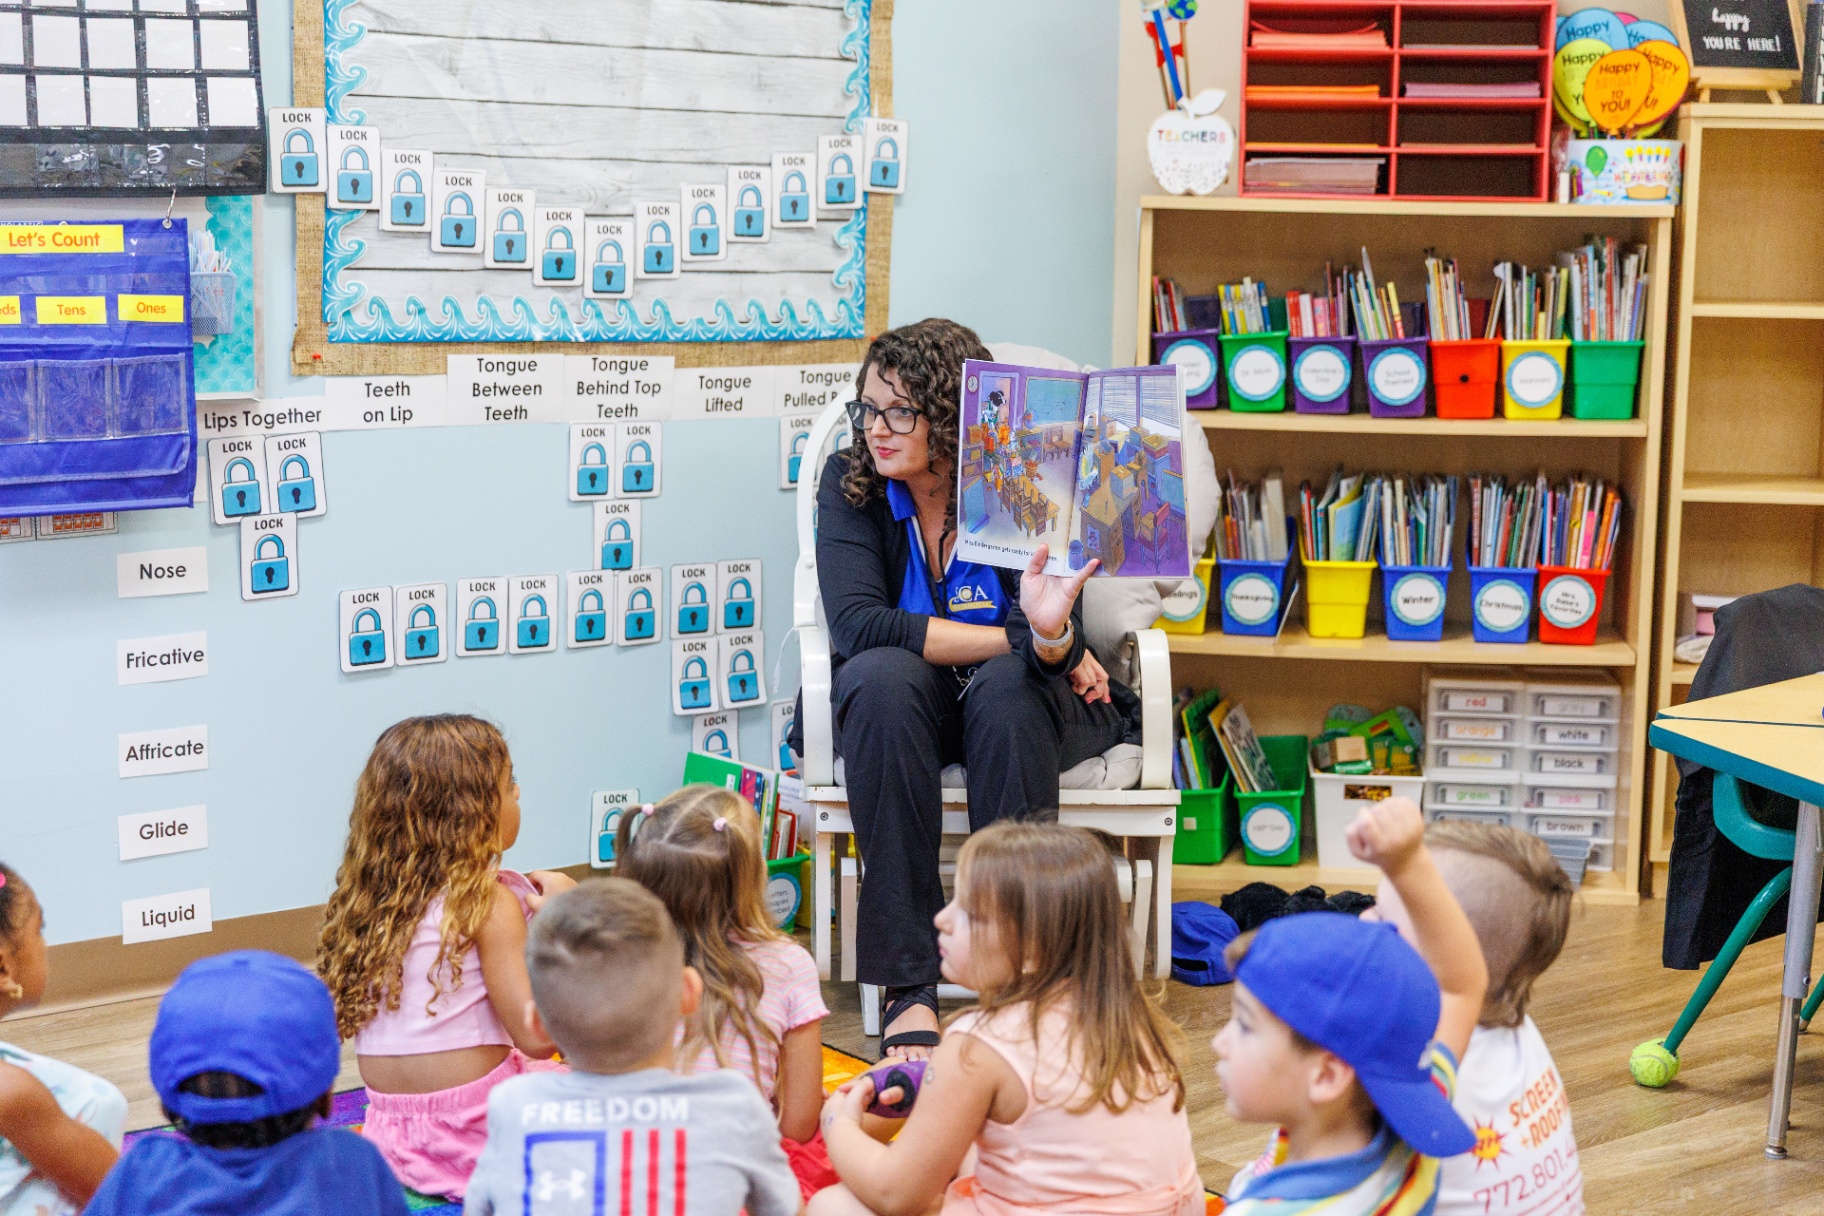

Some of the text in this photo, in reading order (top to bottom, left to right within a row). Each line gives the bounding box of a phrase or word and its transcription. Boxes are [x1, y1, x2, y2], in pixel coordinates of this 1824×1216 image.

[1565, 21, 1610, 40] Happy
[1747, 35, 1781, 52] HERE!
[1562, 51, 1605, 66] Happy
[1599, 62, 1640, 76] Happy
[1601, 98, 1631, 113] YOU!
[282, 113, 312, 123] LOCK
[876, 122, 899, 133] LOCK
[340, 130, 368, 141] LOCK
[1158, 129, 1226, 143] TEACHERS
[829, 138, 852, 149] LOCK
[394, 153, 421, 164] LOCK
[782, 156, 806, 166] LOCK
[738, 170, 761, 180] LOCK
[445, 176, 472, 187] LOCK
[498, 193, 523, 203] LOCK
[692, 188, 715, 198] LOCK
[546, 211, 572, 220] LOCK
[647, 206, 670, 215] LOCK
[597, 225, 622, 235] LOCK
[8, 232, 100, 247] Let's Count
[57, 304, 86, 316] Tens
[137, 302, 166, 314] Ones
[477, 358, 537, 376] Tongue
[591, 357, 649, 374] Tongue
[699, 375, 752, 392] Tongue
[800, 370, 851, 386] Tongue
[364, 381, 411, 398] Teeth
[472, 382, 542, 397] Between
[576, 380, 661, 397] Behind Top
[705, 398, 743, 412] Lifted
[784, 391, 826, 407] Pulled
[363, 406, 413, 424] on Lip
[485, 405, 528, 421] Teeth
[597, 404, 638, 419] Teeth
[204, 408, 322, 433] Lips Together
[790, 418, 813, 428] LOCK
[581, 428, 605, 437] LOCK
[627, 426, 651, 435] LOCK
[222, 441, 252, 453] LOCK
[277, 438, 307, 451] LOCK
[605, 504, 630, 514] LOCK
[254, 518, 284, 531] LOCK
[139, 563, 187, 580] Nose
[682, 568, 706, 578] LOCK
[728, 563, 751, 573] LOCK
[578, 575, 603, 584] LOCK
[628, 573, 652, 583] LOCK
[469, 582, 496, 592] LOCK
[520, 579, 546, 590] LOCK
[352, 592, 380, 604] LOCK
[409, 589, 435, 600] LOCK
[683, 642, 707, 652] LOCK
[730, 636, 754, 646] LOCK
[126, 648, 204, 669] Fricative
[1465, 693, 1486, 706] red
[703, 715, 728, 727] LOCK
[1455, 723, 1496, 737] orange
[1558, 730, 1589, 740] white
[125, 740, 204, 762] Affricate
[1554, 757, 1584, 768] black
[603, 794, 628, 804] LOCK
[139, 820, 189, 840] Glide
[1546, 822, 1584, 832] brown
[141, 904, 195, 928] Liquid
[1509, 1066, 1559, 1127] SCREEN
[521, 1096, 689, 1126] FREEDOM
